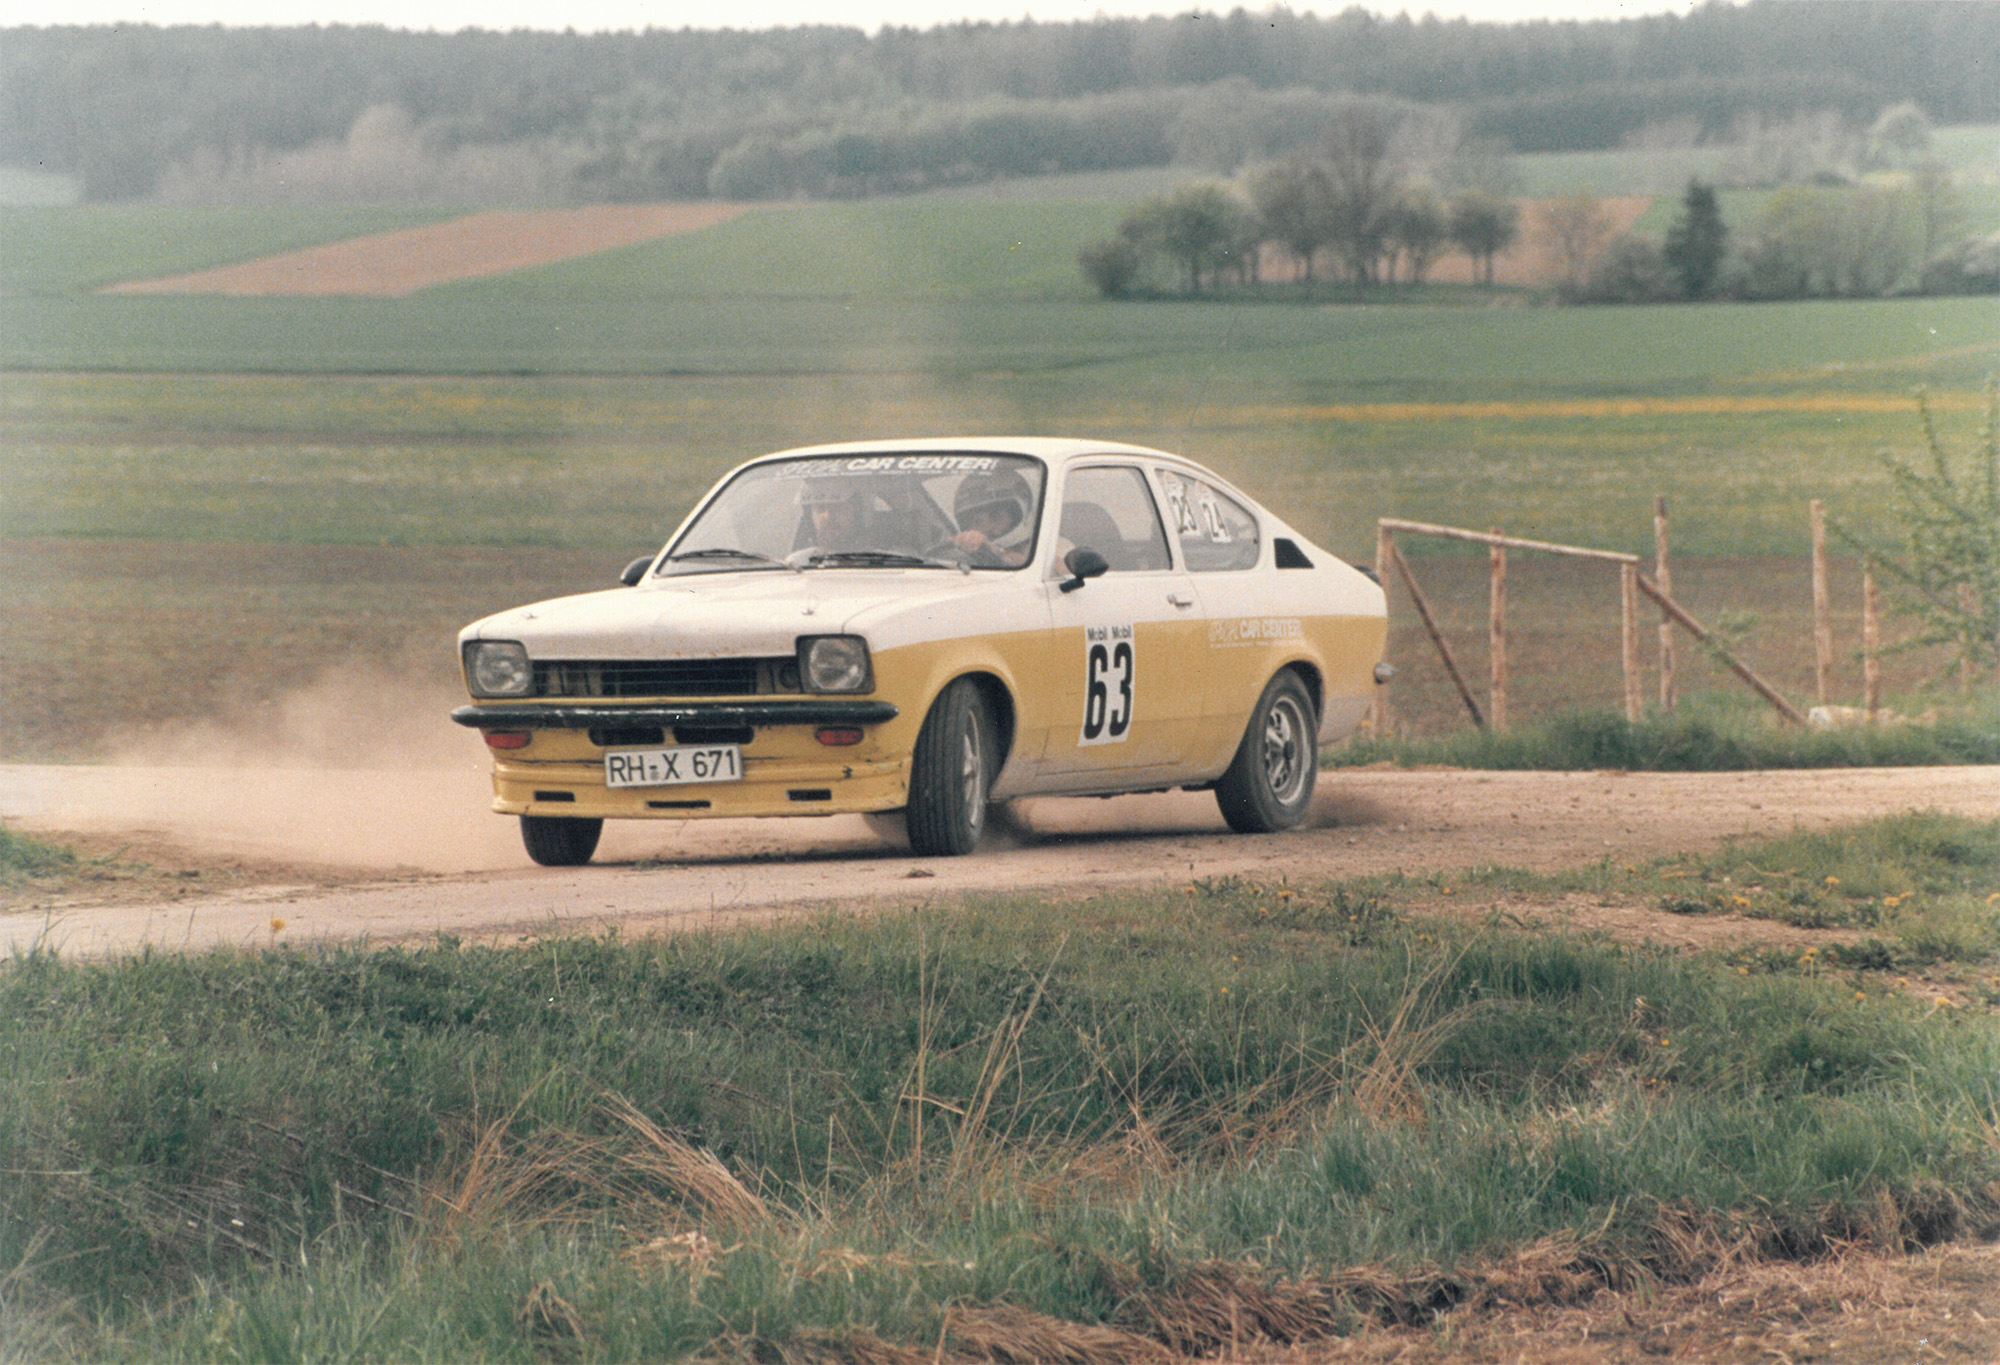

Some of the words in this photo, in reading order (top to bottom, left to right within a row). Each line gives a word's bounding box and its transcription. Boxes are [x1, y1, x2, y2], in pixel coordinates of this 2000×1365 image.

[847, 457, 896, 471] CAR
[1202, 503, 1229, 537] 24
[1087, 626, 1108, 641] Mobil
[1111, 624, 1132, 640] Mobil
[1240, 620, 1260, 639] CAR
[1084, 642, 1132, 740] 63
[692, 749, 735, 778] 671
